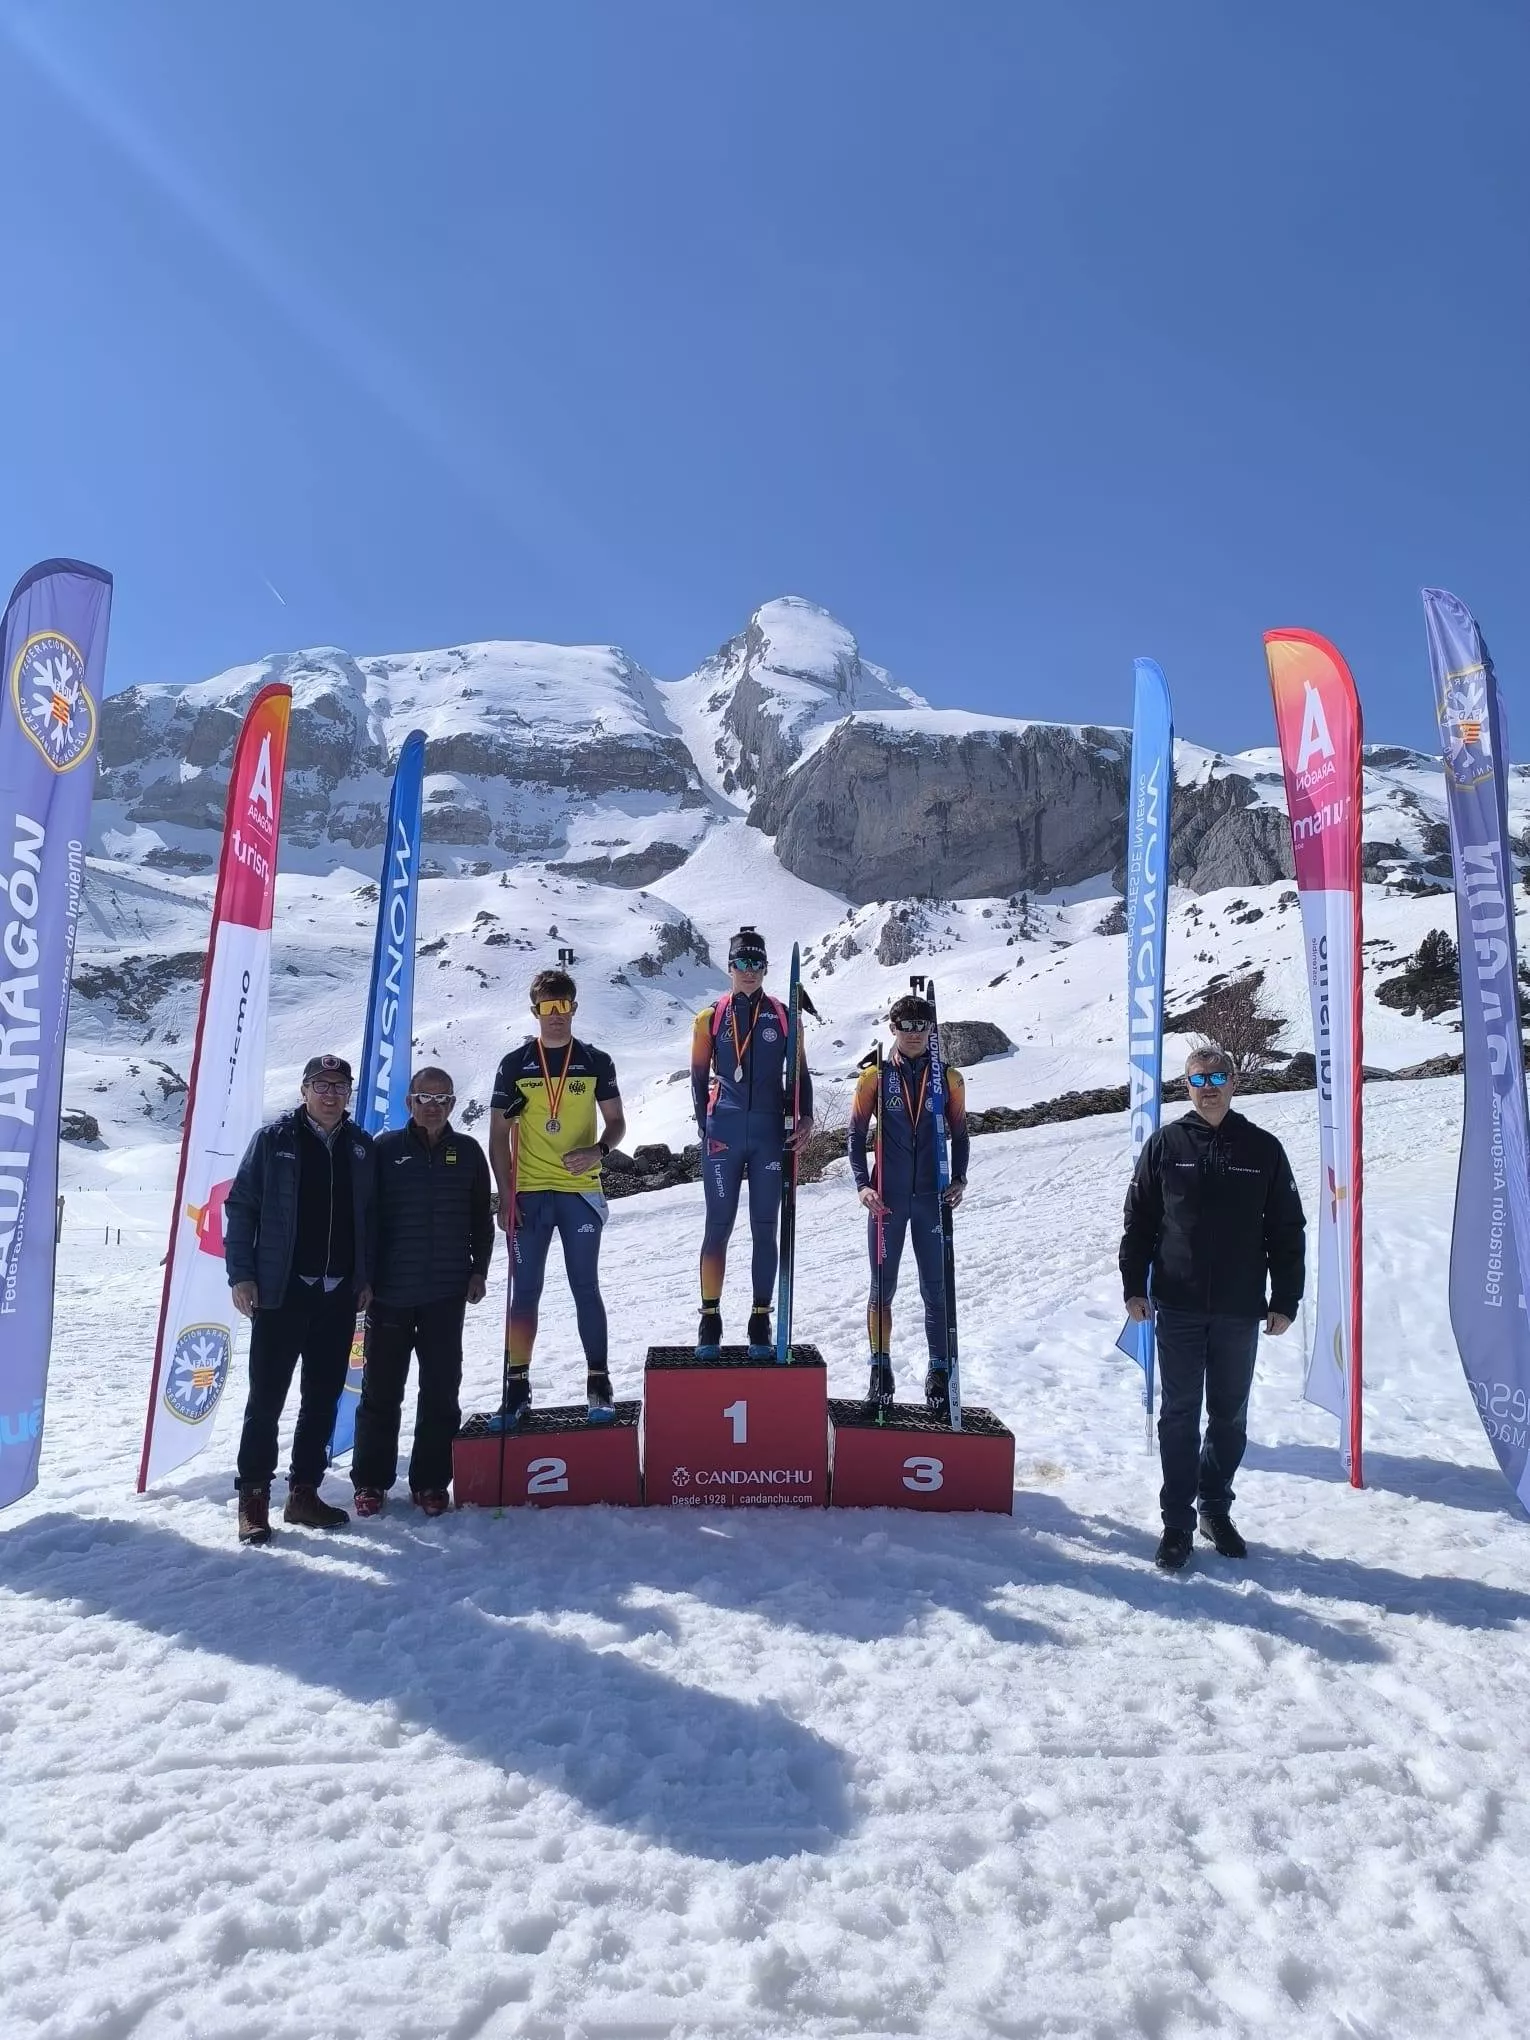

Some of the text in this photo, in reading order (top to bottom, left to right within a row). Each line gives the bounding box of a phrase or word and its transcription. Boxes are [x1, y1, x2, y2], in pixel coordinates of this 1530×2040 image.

[248, 804, 273, 837] ARAGÓN
[65, 839, 83, 917] Invierno
[930, 1032, 943, 1095] SALOMON
[714, 1163, 726, 1198] turismo
[722, 1399, 748, 1444] 1
[526, 1456, 569, 1495] 2
[695, 1470, 813, 1485] CANDANCHU
[901, 1455, 944, 1493] 3
[671, 1492, 813, 1505] Desde 1928 candanchu.com
